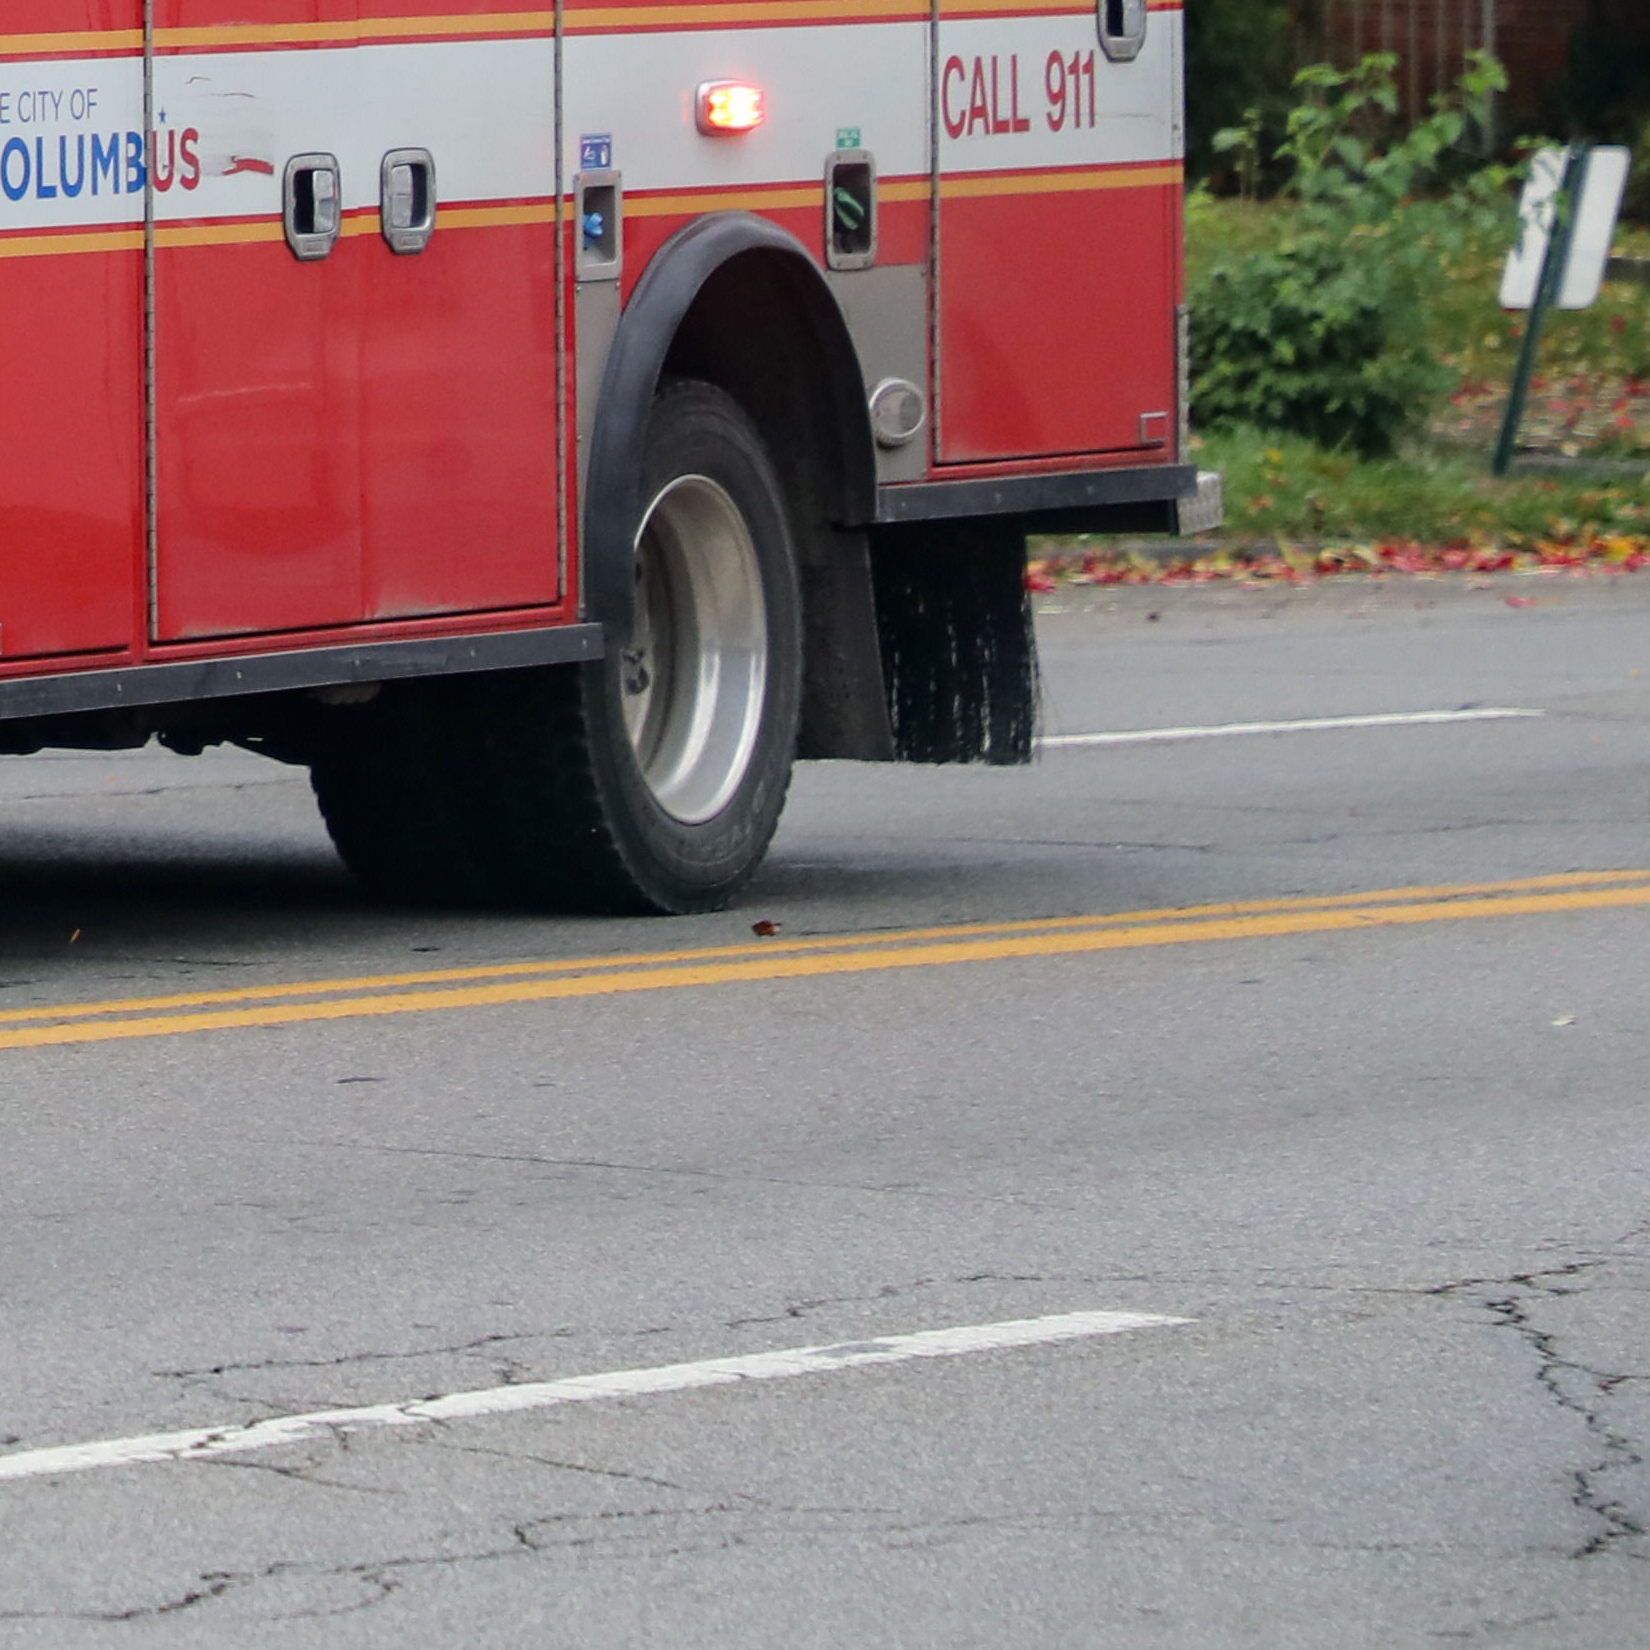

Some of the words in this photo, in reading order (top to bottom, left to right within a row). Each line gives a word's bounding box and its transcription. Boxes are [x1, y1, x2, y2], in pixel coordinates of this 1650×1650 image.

[18, 90, 64, 125] CITY
[69, 88, 99, 122] OF
[942, 53, 1030, 140] CALL
[1045, 49, 1096, 132] 911
